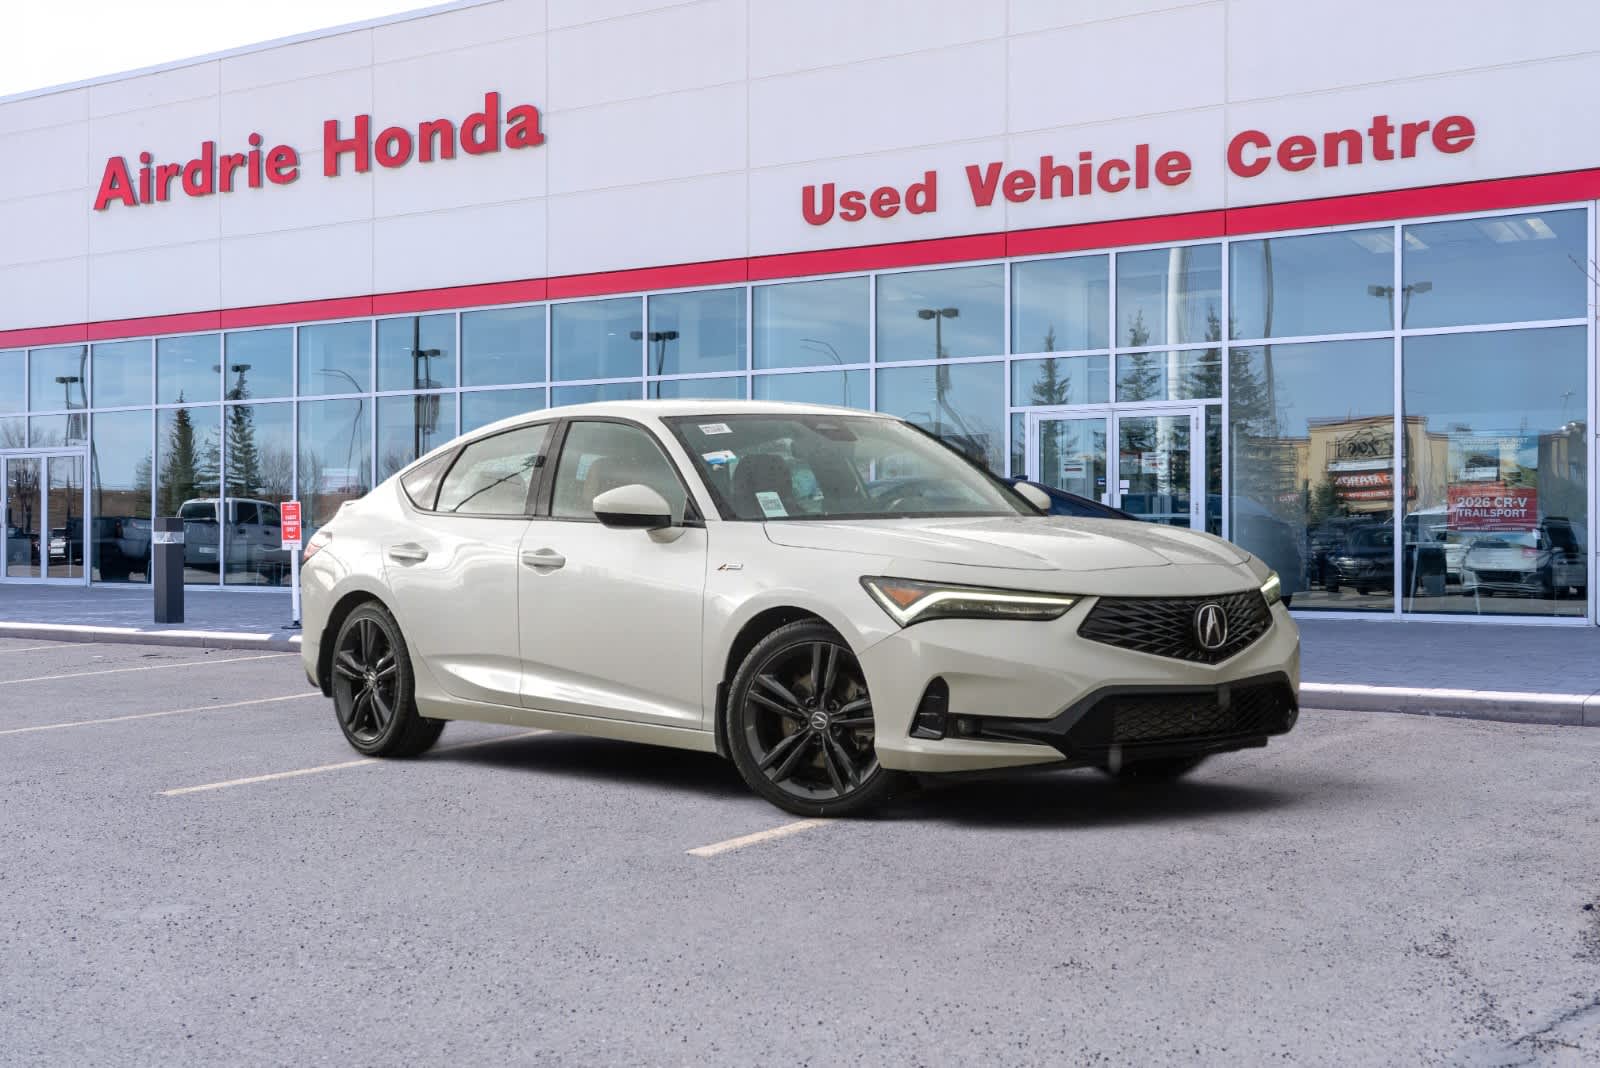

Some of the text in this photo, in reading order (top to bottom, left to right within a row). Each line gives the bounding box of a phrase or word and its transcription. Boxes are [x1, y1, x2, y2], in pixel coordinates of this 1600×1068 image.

[94, 91, 546, 211] Airdrie Honda
[802, 114, 1477, 226] Used Vehicle Centre
[1457, 497, 1527, 508] 2026 CR-V
[1458, 509, 1528, 517] TRAILSPORT
